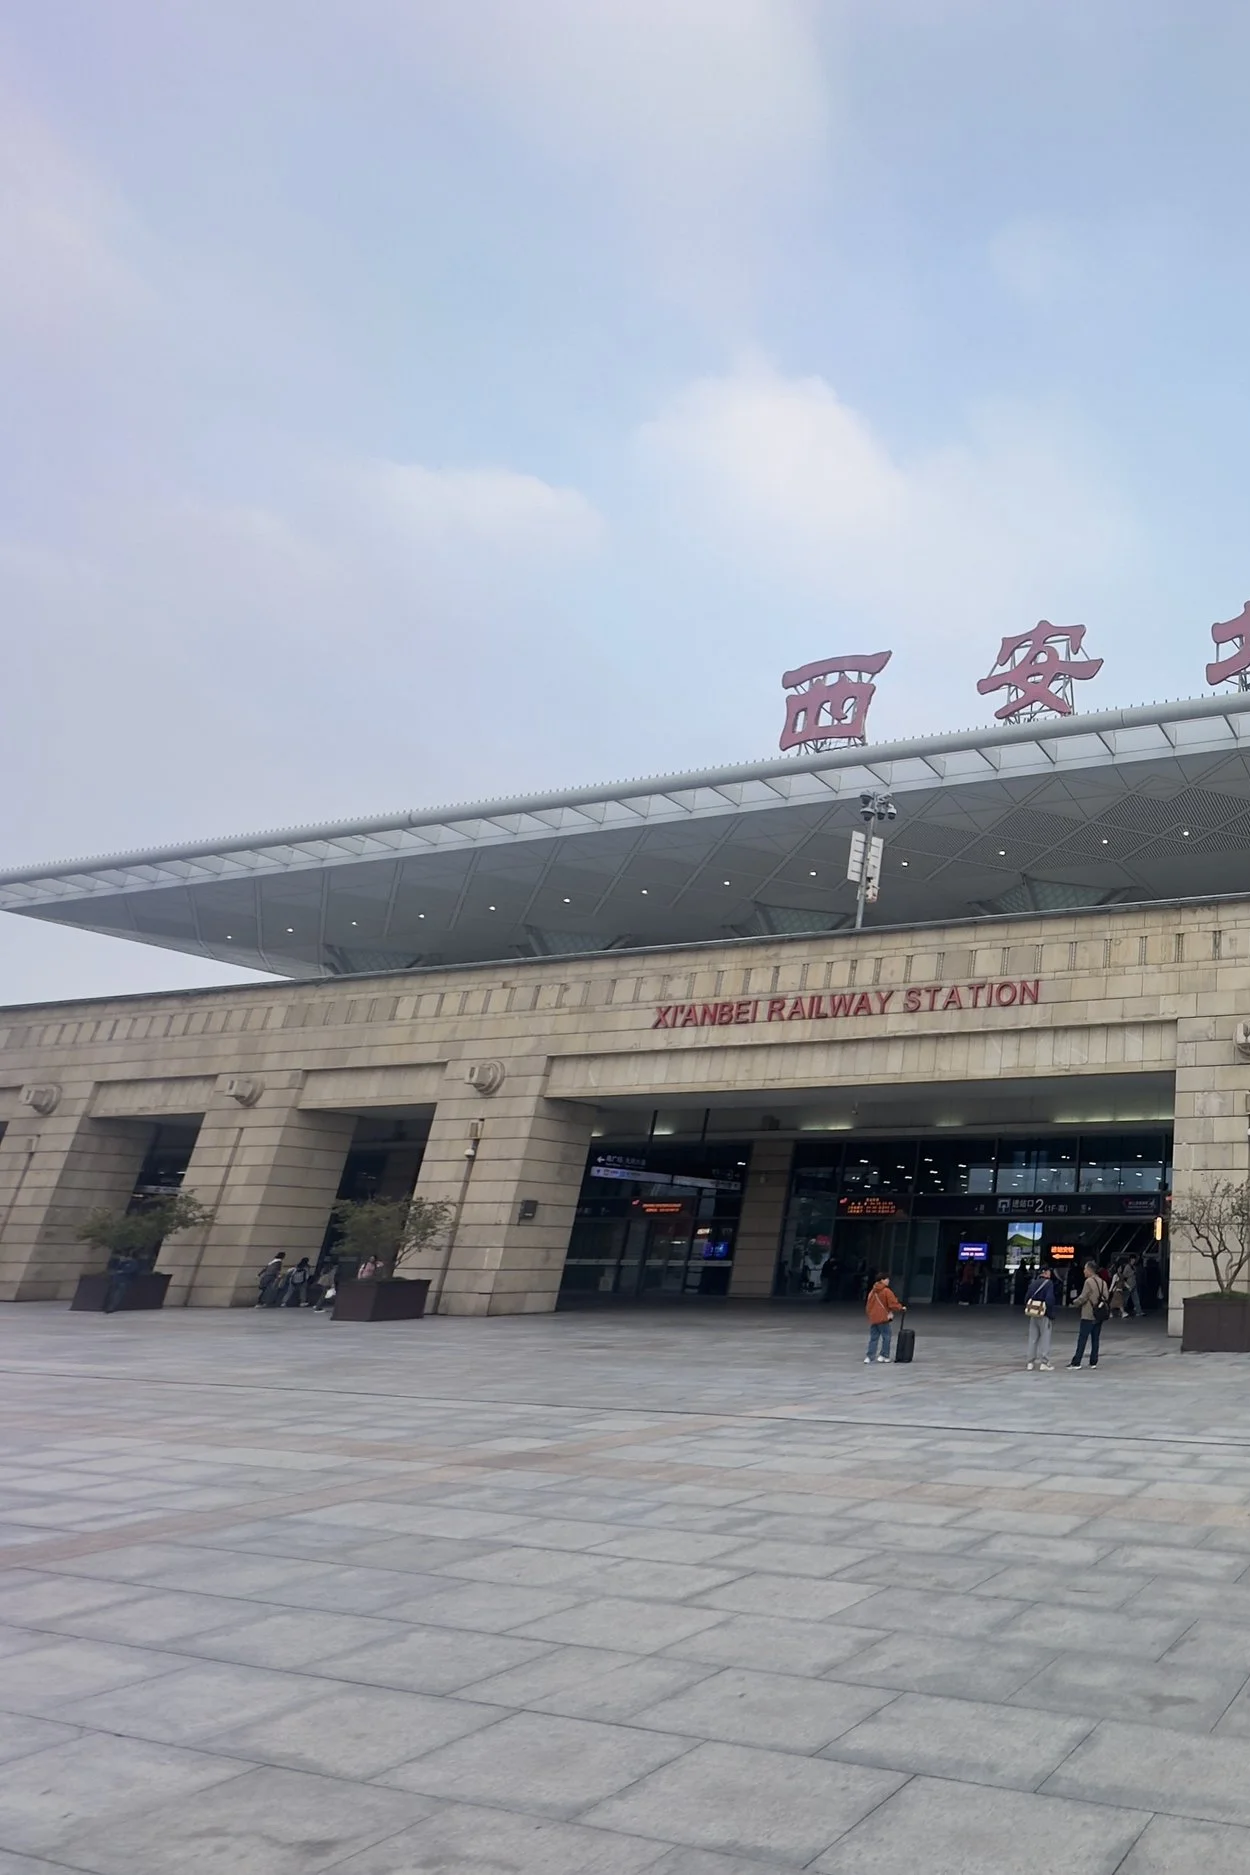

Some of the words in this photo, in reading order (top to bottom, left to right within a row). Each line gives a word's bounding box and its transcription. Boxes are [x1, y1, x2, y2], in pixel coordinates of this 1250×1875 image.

[651, 1000, 759, 1029] XI'ANBEI
[766, 990, 895, 1022] RAILWAY
[903, 979, 1041, 1013] STATION
